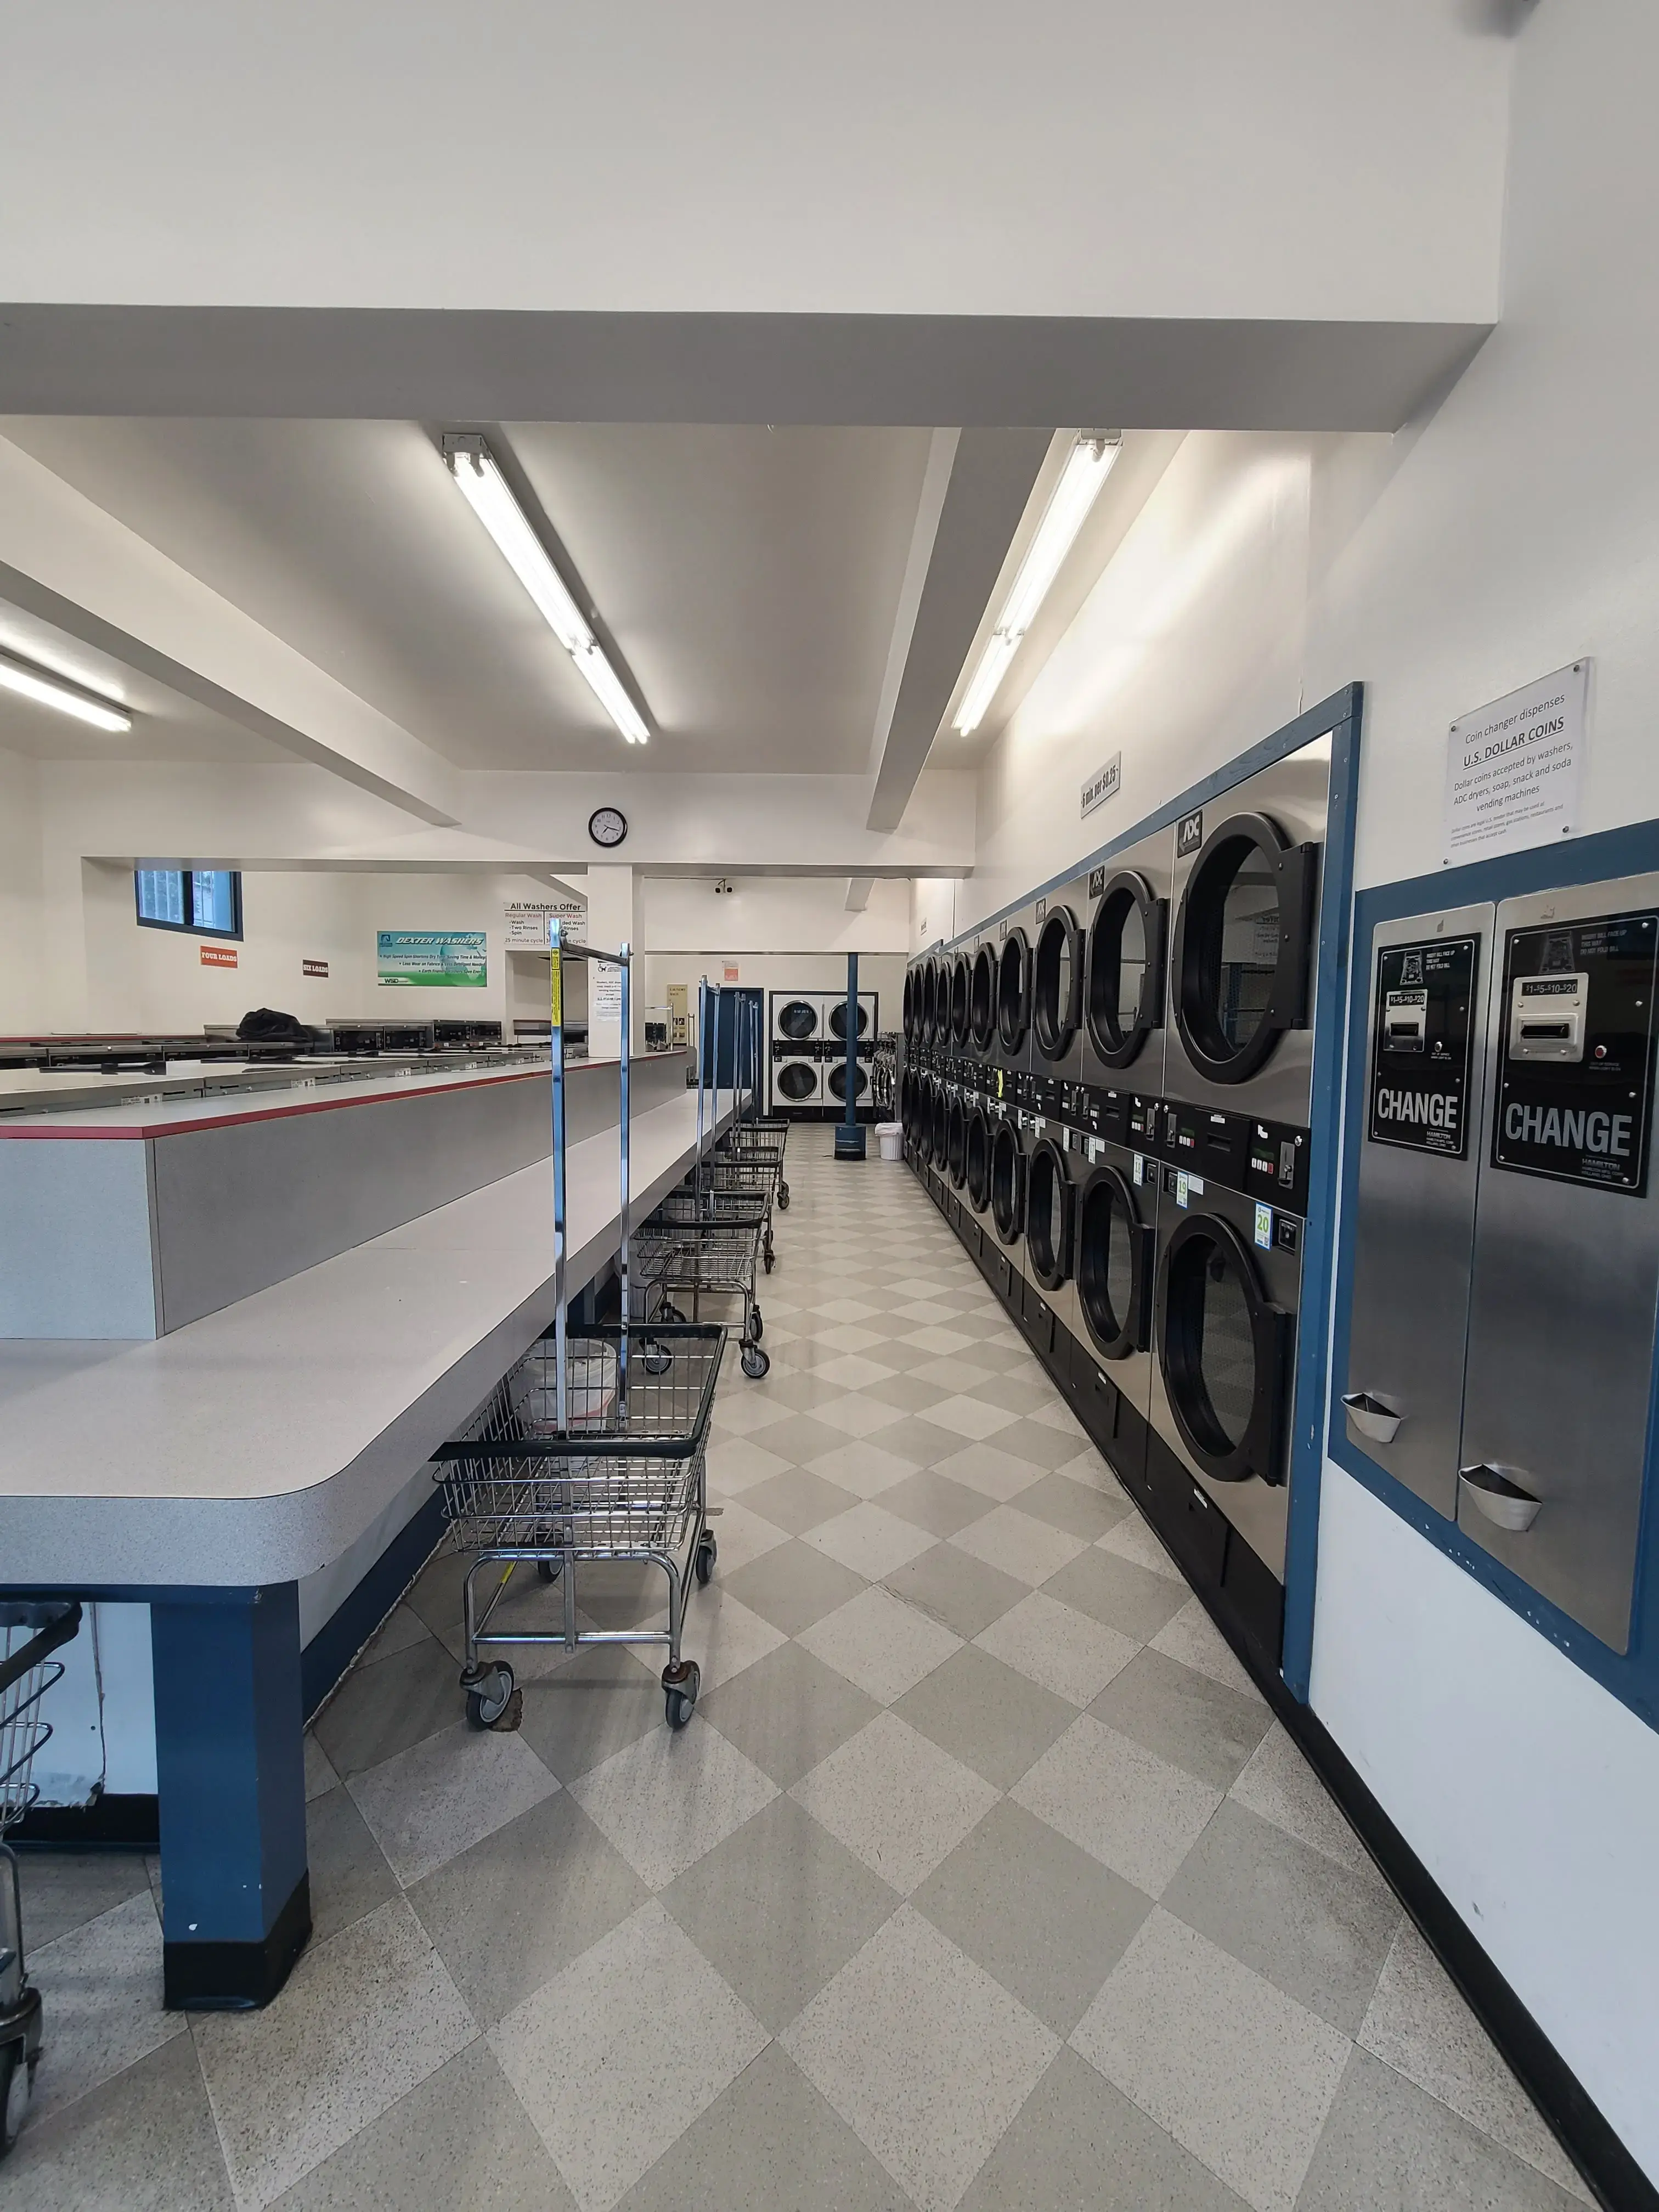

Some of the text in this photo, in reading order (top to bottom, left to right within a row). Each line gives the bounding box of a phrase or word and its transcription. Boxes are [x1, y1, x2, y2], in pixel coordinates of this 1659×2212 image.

[1466, 695, 1565, 744] Coin changer dispenses
[1464, 716, 1564, 766] U.S. DOLLAR COINS
[1102, 764, 1116, 791] $0.25
[1454, 742, 1573, 791] Dollar coins accepted by washers,
[1454, 758, 1571, 805] ADC dryers, soap, snack and soda
[1476, 785, 1540, 811] vending machines
[1183, 814, 1200, 843] ADC
[201, 951, 238, 962] FOUR LOADS
[1378, 1088, 1458, 1128] CHANGE
[1426, 1131, 1451, 1140] HAMILTON
[1505, 1103, 1632, 1156] CHANGE
[1135, 1161, 1141, 1174] 18
[1582, 1158, 1620, 1171] HAMILTON
[1179, 1180, 1186, 1195] 19
[1257, 1214, 1269, 1233] 20
